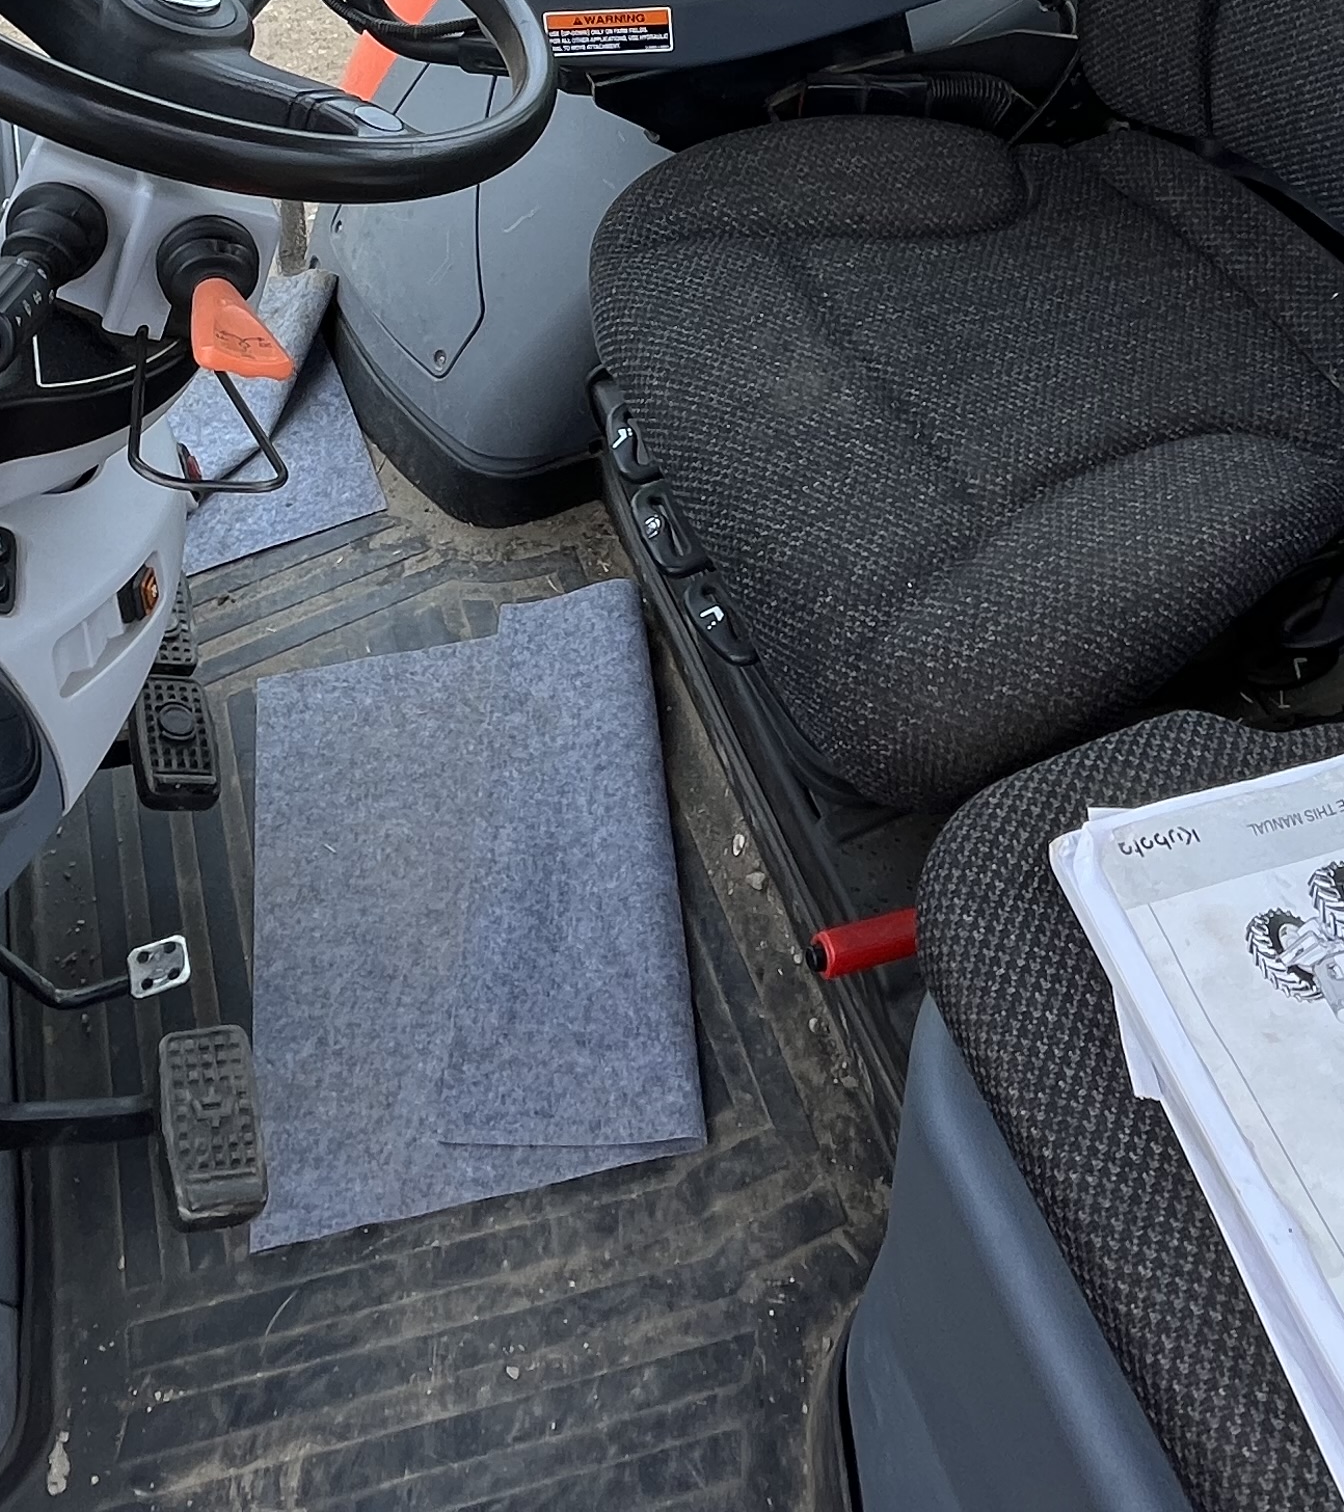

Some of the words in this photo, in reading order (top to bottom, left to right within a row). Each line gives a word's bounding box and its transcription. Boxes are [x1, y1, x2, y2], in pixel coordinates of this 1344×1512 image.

[584, 13, 646, 25] WARNING
[1247, 812, 1304, 837] MANUAL
[1304, 805, 1337, 823] THIS
[1118, 826, 1201, 858] Kubota
